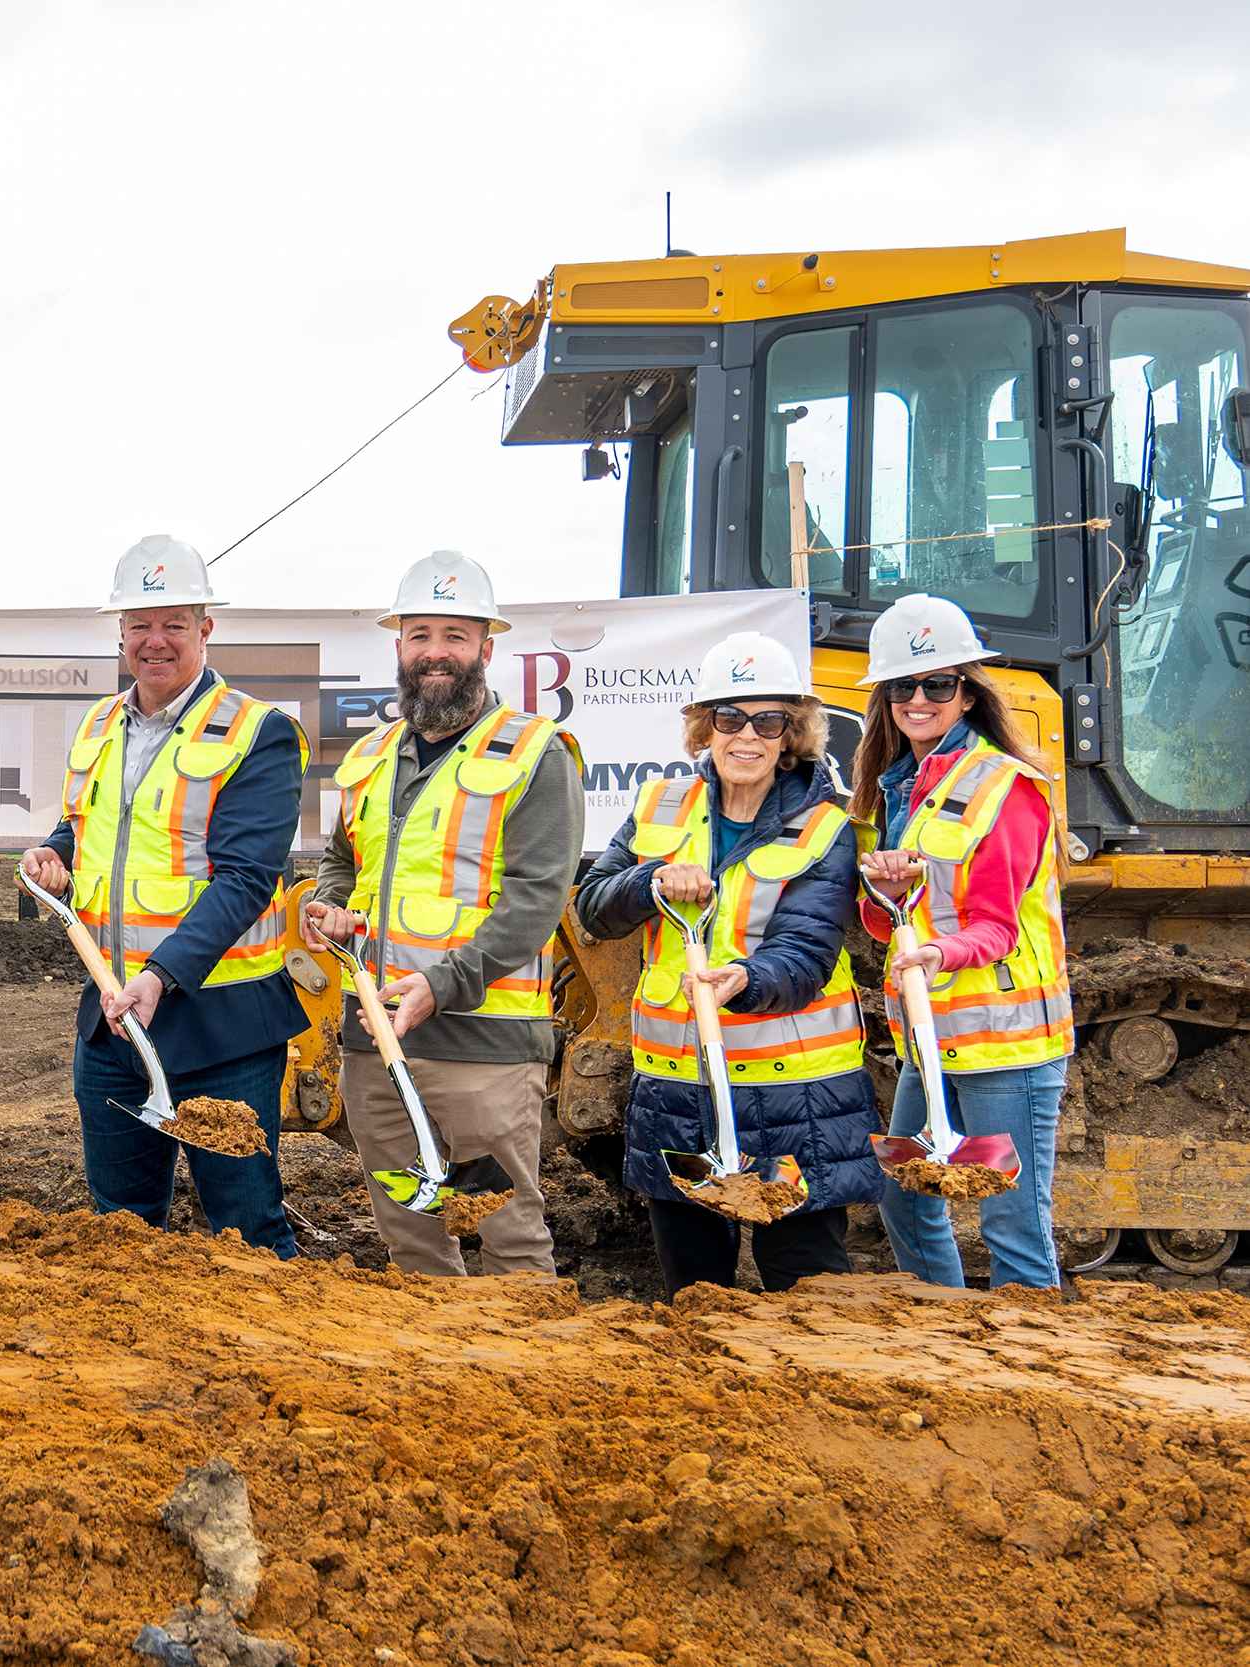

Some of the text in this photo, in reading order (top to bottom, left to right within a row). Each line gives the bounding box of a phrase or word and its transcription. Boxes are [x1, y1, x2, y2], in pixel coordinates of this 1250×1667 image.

[584, 666, 701, 688] BUCKMA
[582, 692, 684, 705] PARTNERSHIP,
[582, 761, 705, 792] MYCO
[587, 794, 629, 808] NERAL
